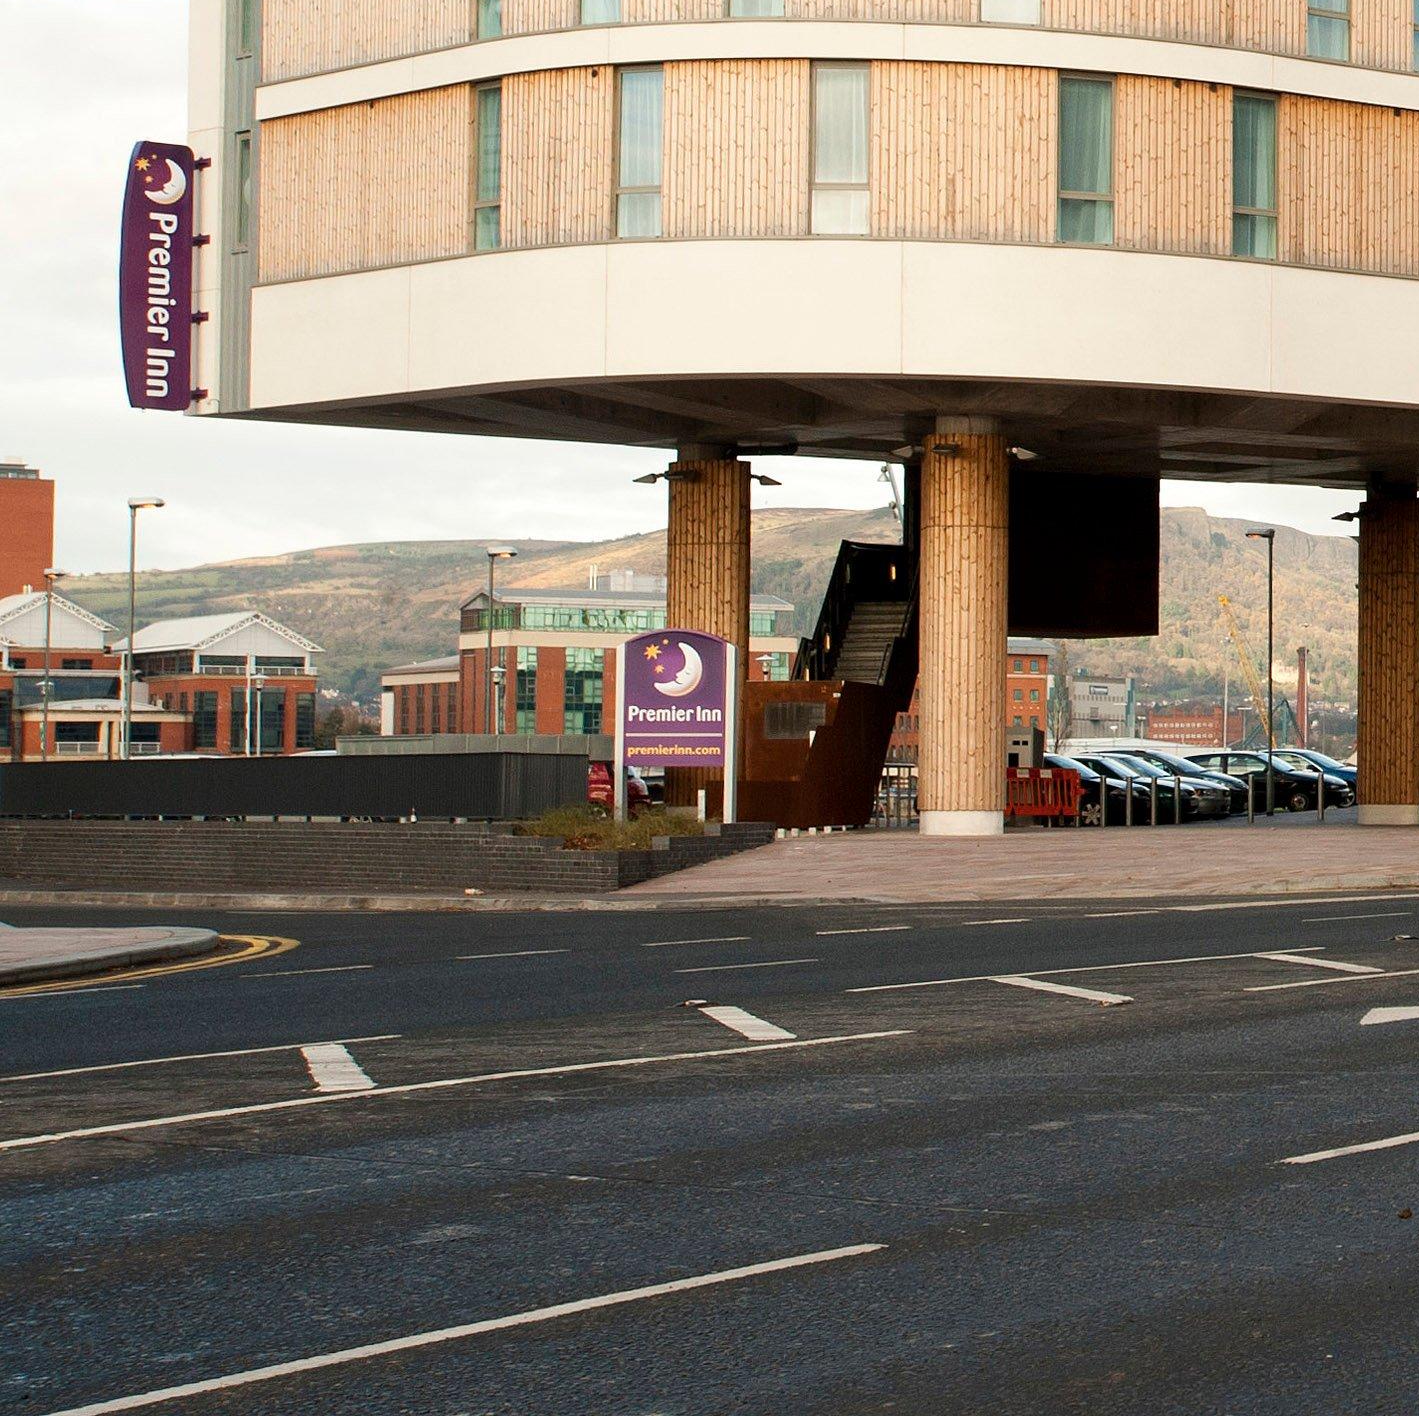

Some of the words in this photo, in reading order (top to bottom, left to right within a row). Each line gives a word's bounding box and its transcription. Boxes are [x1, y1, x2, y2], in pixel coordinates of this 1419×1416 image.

[146, 212, 178, 343] Premier
[146, 347, 176, 398] Inn
[628, 705, 695, 722] Premier
[696, 705, 722, 722] Inn
[627, 743, 721, 758] premierinn.com
